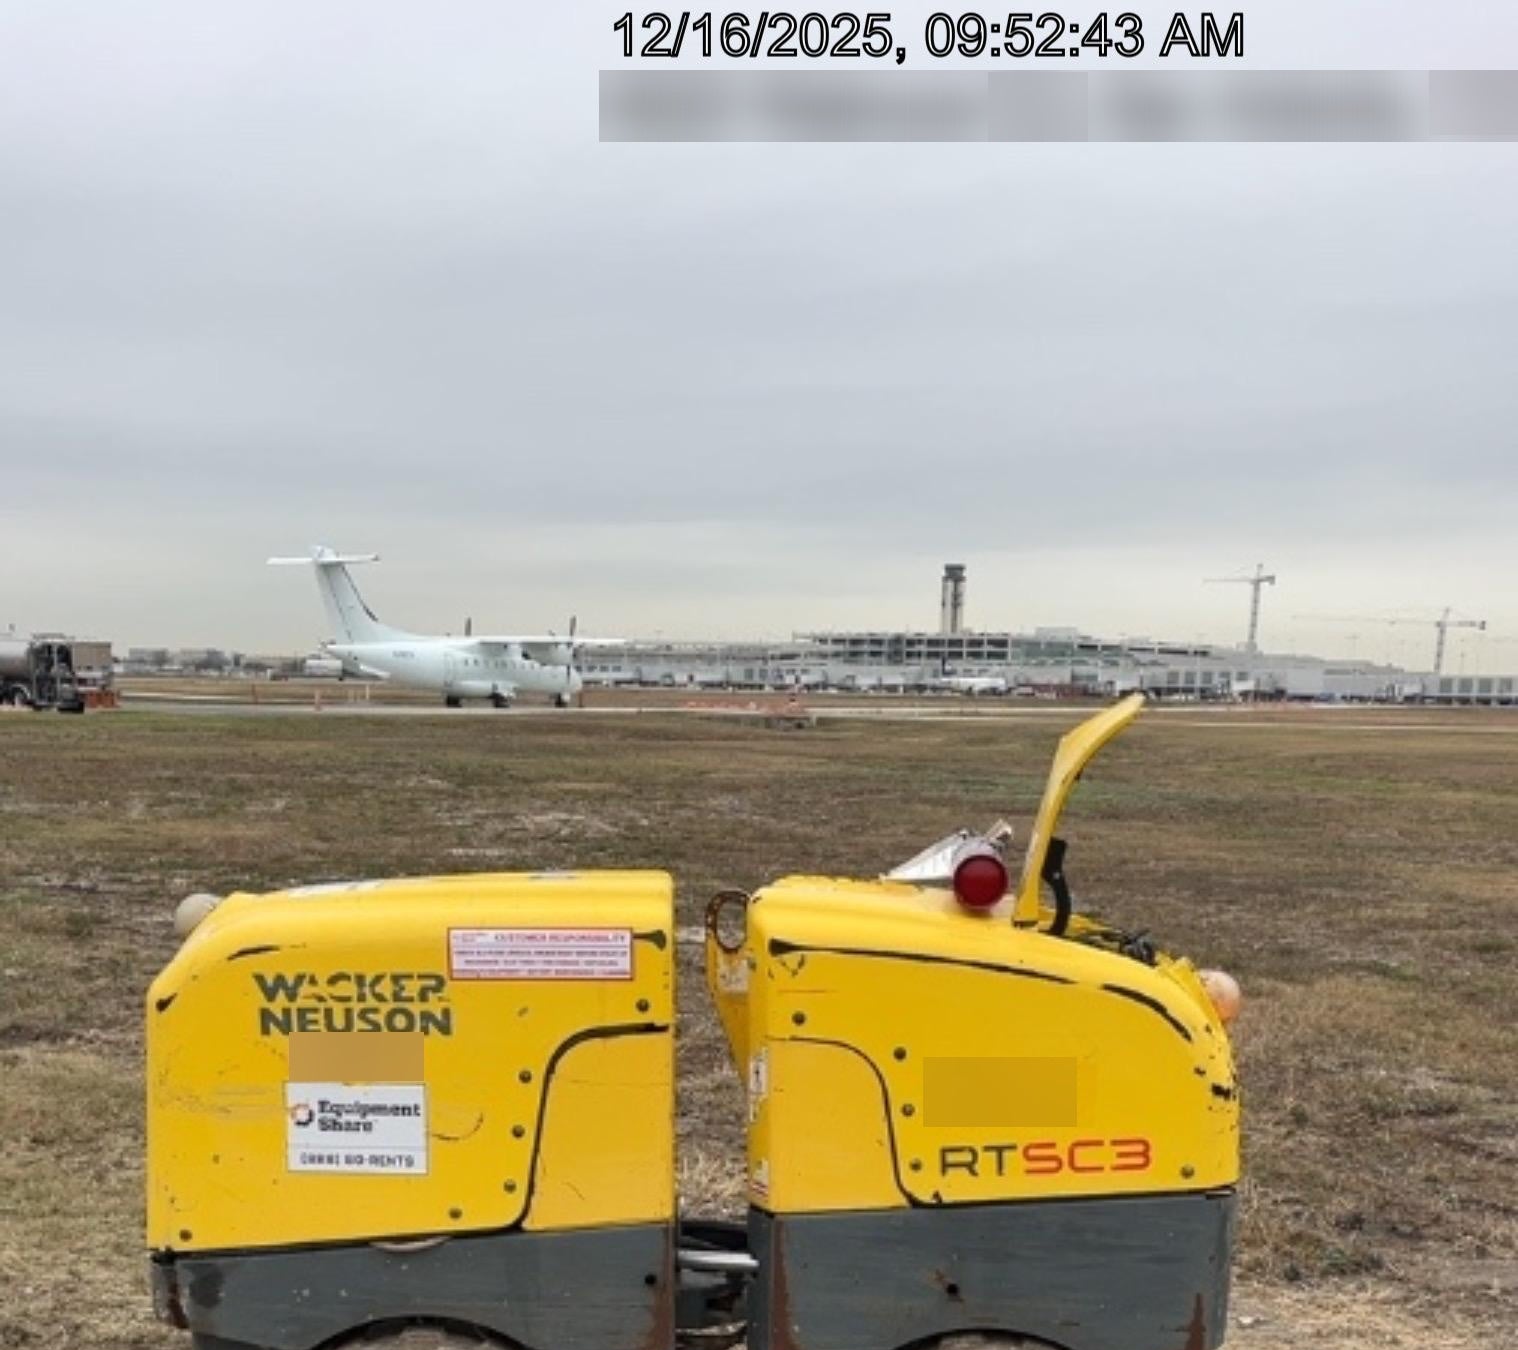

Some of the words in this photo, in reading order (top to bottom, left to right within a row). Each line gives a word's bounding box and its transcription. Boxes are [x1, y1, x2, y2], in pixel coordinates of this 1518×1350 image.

[259, 1006, 453, 1036] NEUSON
[317, 1099, 421, 1119] Equipment
[317, 1117, 374, 1133] Share
